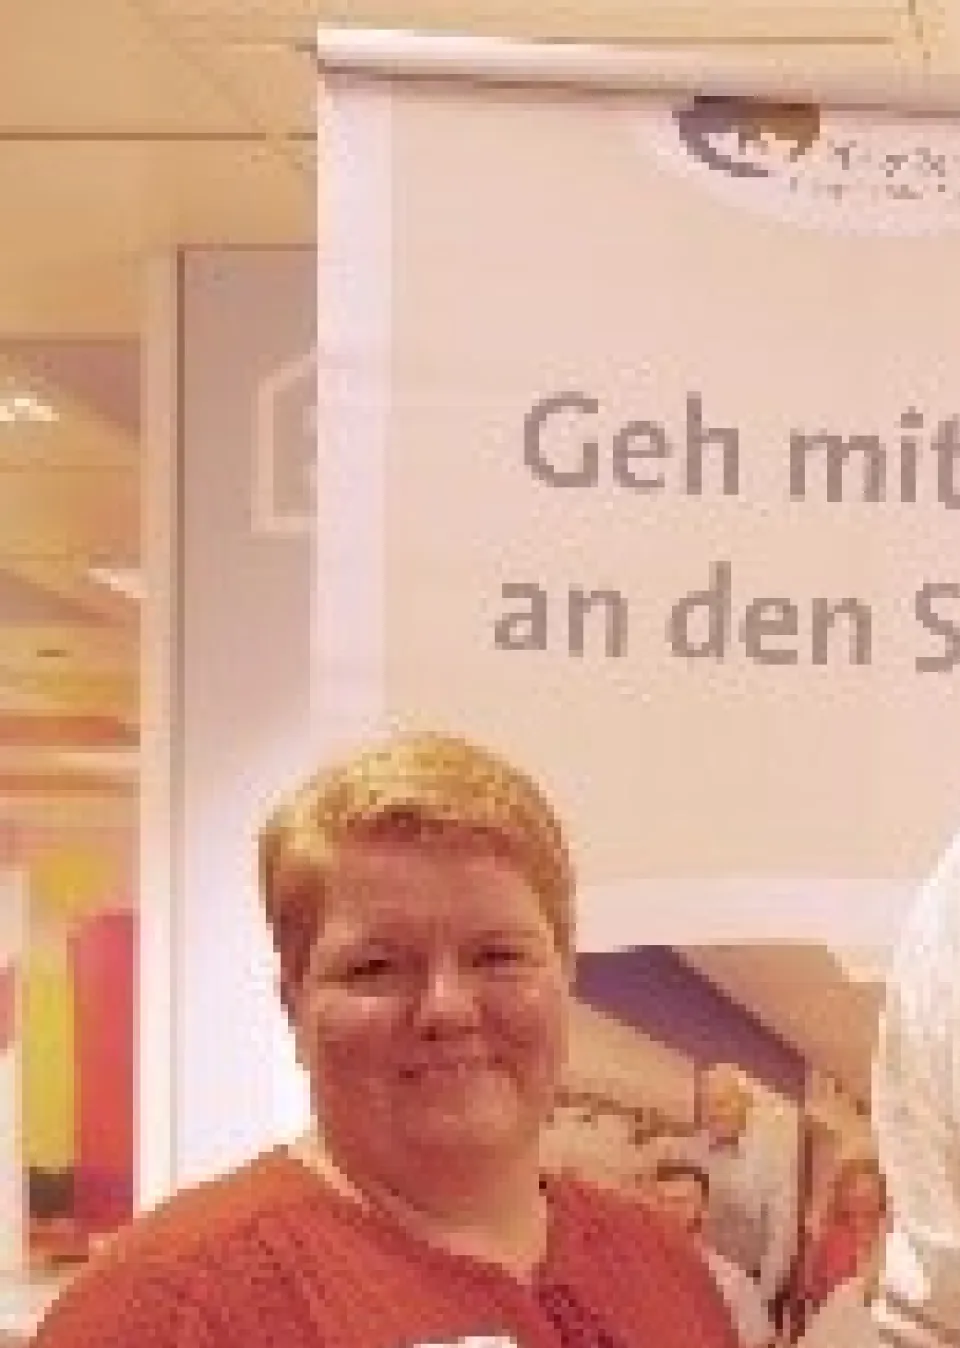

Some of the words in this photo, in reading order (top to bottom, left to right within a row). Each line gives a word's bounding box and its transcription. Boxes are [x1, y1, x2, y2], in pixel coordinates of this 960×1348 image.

[523, 391, 739, 495] Geh
[495, 582, 629, 658] an
[666, 560, 872, 665] den
